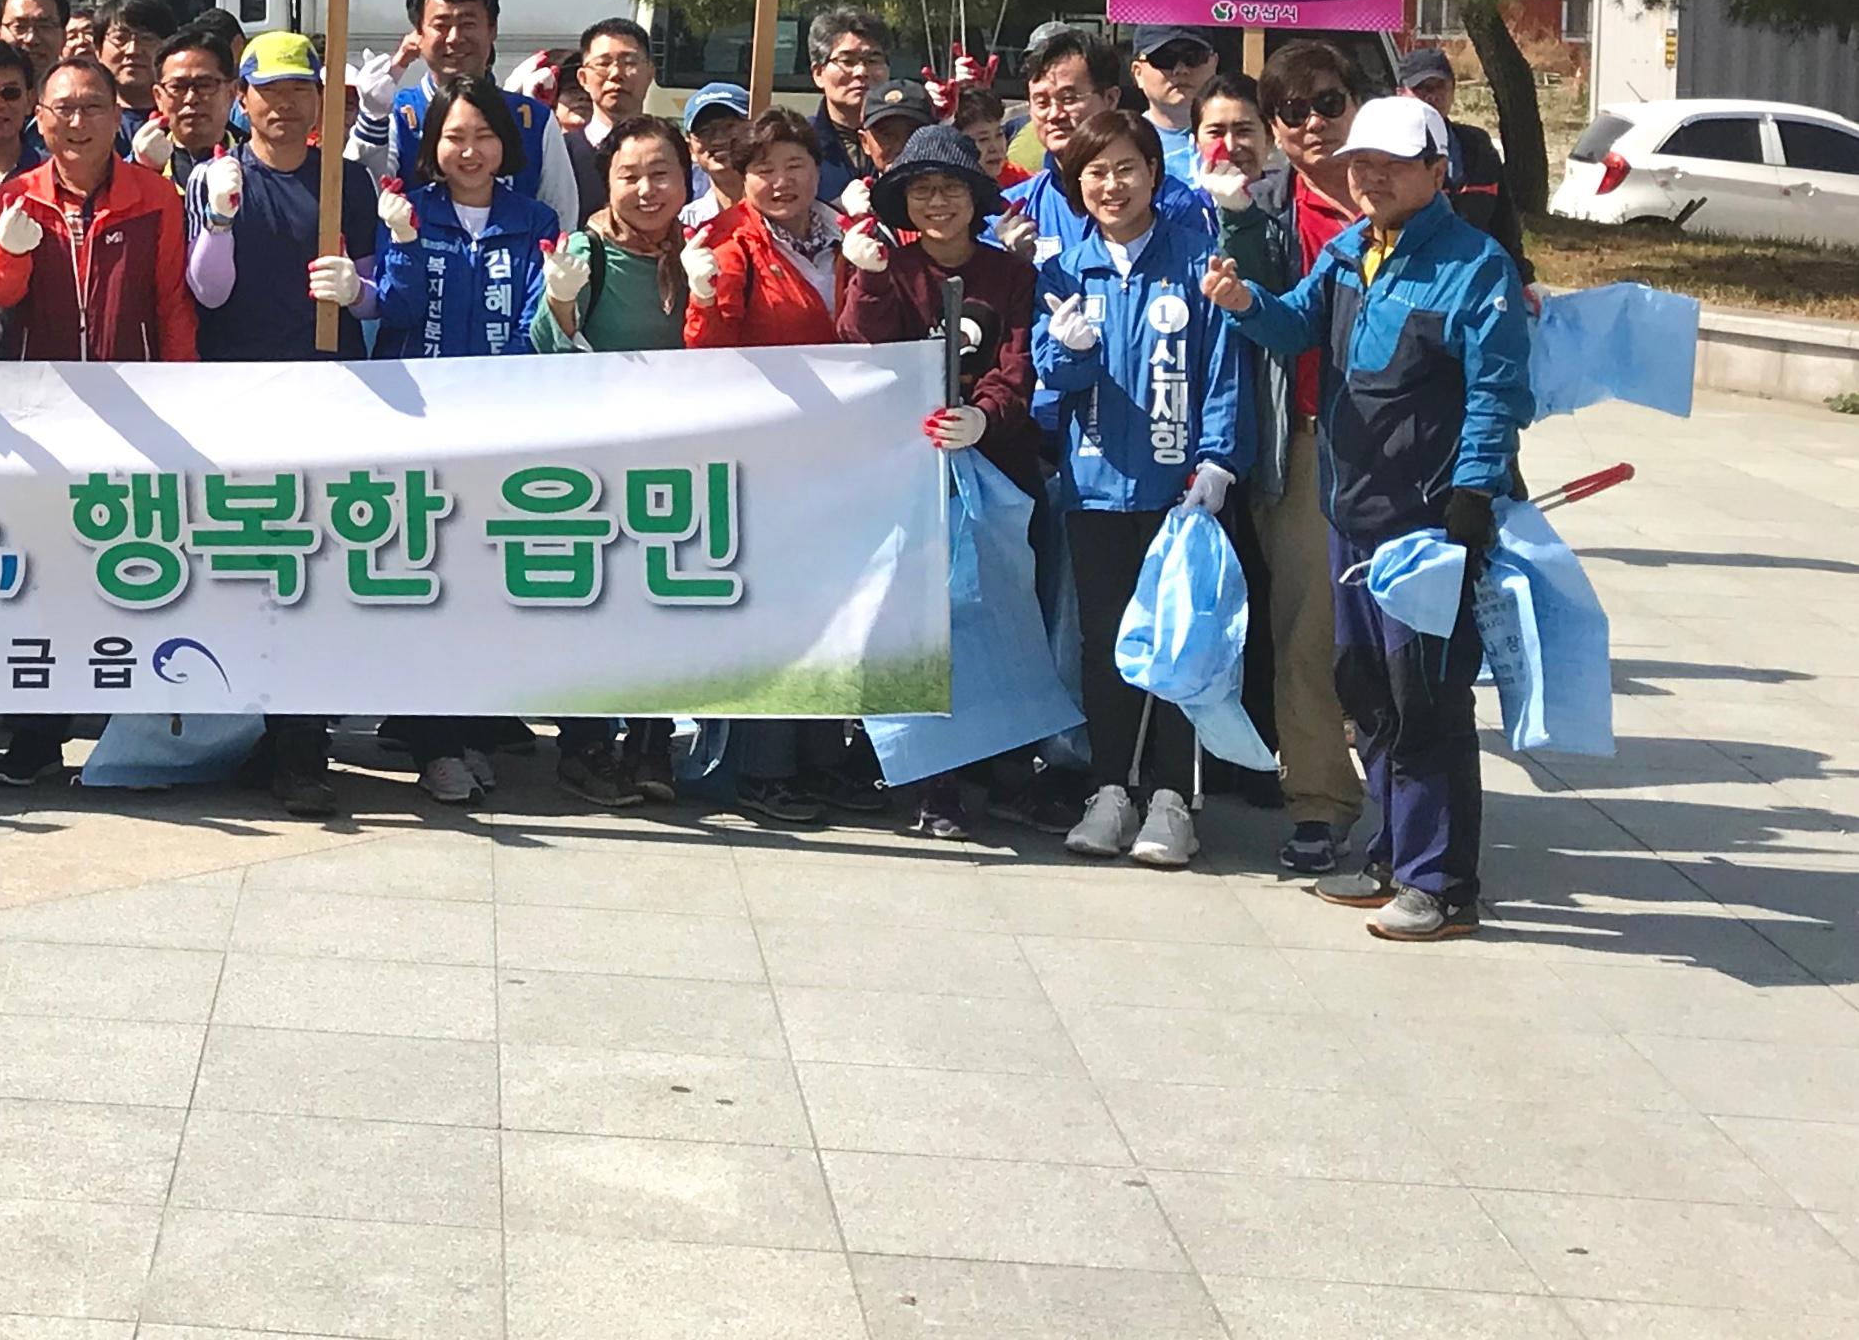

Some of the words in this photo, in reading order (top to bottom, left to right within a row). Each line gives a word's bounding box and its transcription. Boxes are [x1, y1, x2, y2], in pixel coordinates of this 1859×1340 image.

[1240, 4, 1298, 22] 양산시
[517, 104, 532, 128] 1
[1157, 304, 1170, 324] 1
[1149, 339, 1189, 465] 신재향
[69, 467, 448, 604] 행복한
[485, 462, 742, 600] 읍민
